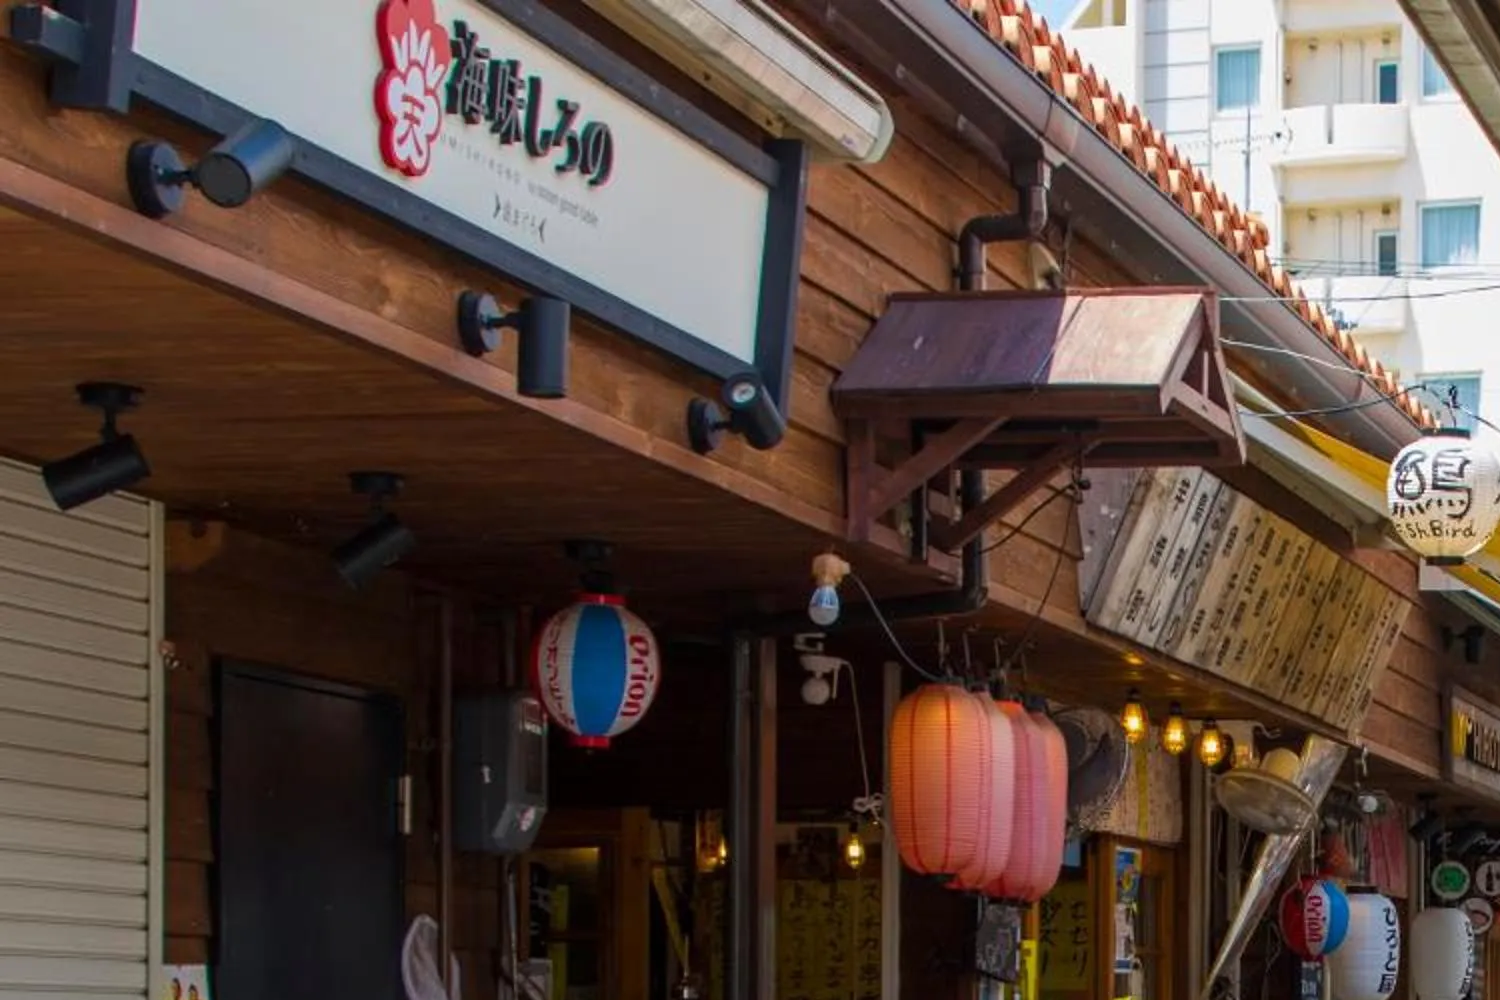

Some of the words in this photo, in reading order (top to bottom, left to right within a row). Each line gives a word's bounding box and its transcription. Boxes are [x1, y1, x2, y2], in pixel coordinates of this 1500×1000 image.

[445, 19, 614, 187] 海味しろの
[620, 634, 654, 717] Orion
[1306, 895, 1328, 943] Orion
